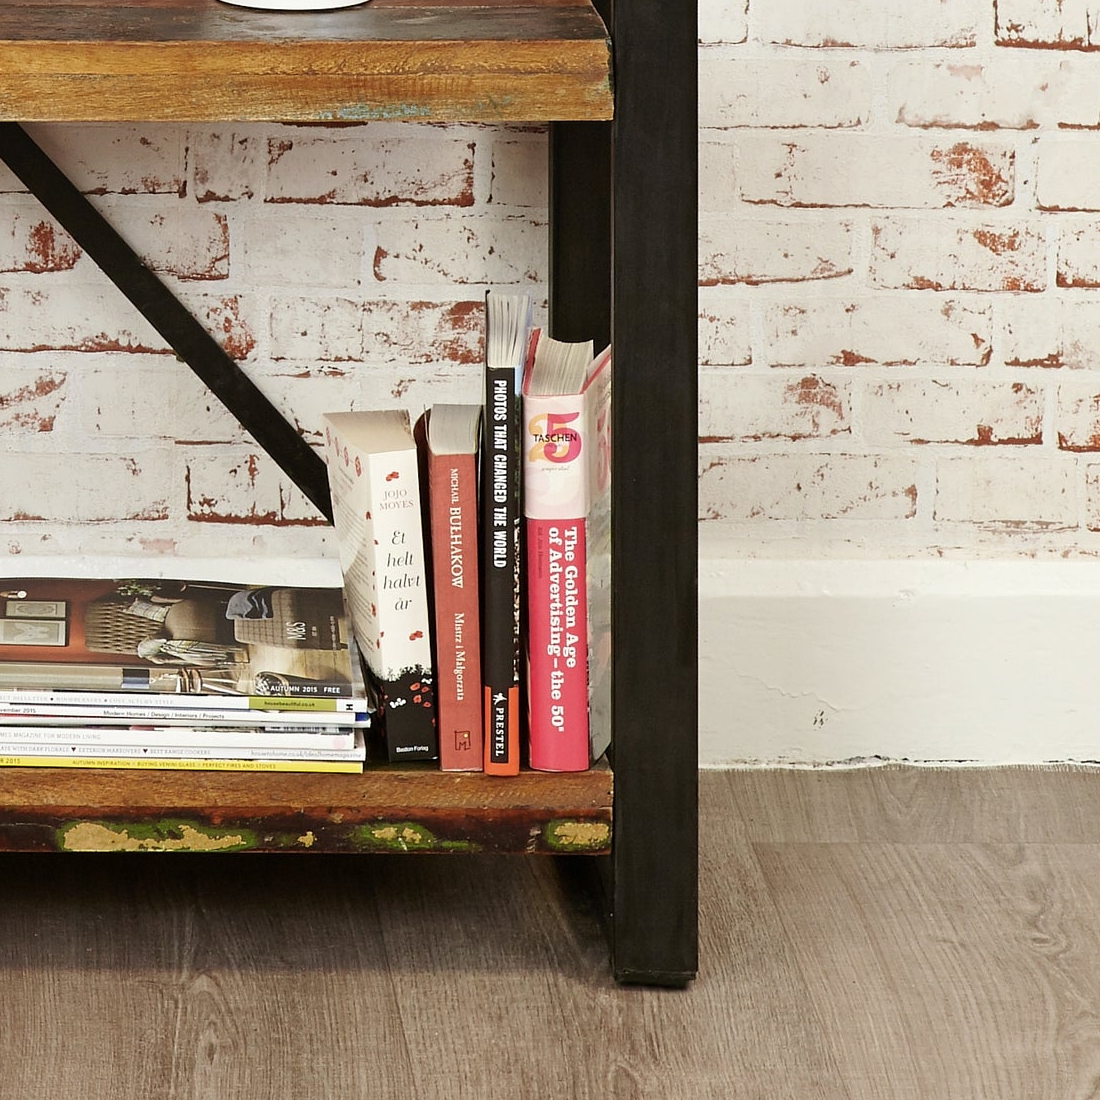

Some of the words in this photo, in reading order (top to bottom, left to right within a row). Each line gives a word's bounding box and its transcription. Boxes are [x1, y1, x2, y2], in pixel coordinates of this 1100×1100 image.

[493, 379, 507, 421] PHOTOS
[493, 424, 507, 451] THAT
[533, 433, 578, 443] TASCHEN
[493, 454, 507, 503] CHANGED
[379, 500, 414, 511] MOYES
[383, 489, 408, 500] JOJO
[493, 506, 507, 527] THE
[391, 530, 406, 545] Et
[450, 507, 463, 589] BUŁHAKOW
[493, 530, 507, 568] WORLD
[549, 527, 563, 544] of
[565, 526, 578, 562] The
[387, 551, 414, 567] helt
[383, 574, 420, 590] halvt
[565, 565, 578, 628] Golden
[286, 621, 306, 640] M&S
[454, 613, 465, 643] Mistrz
[563, 633, 579, 668] Age
[495, 707, 504, 757] PRESTEL
